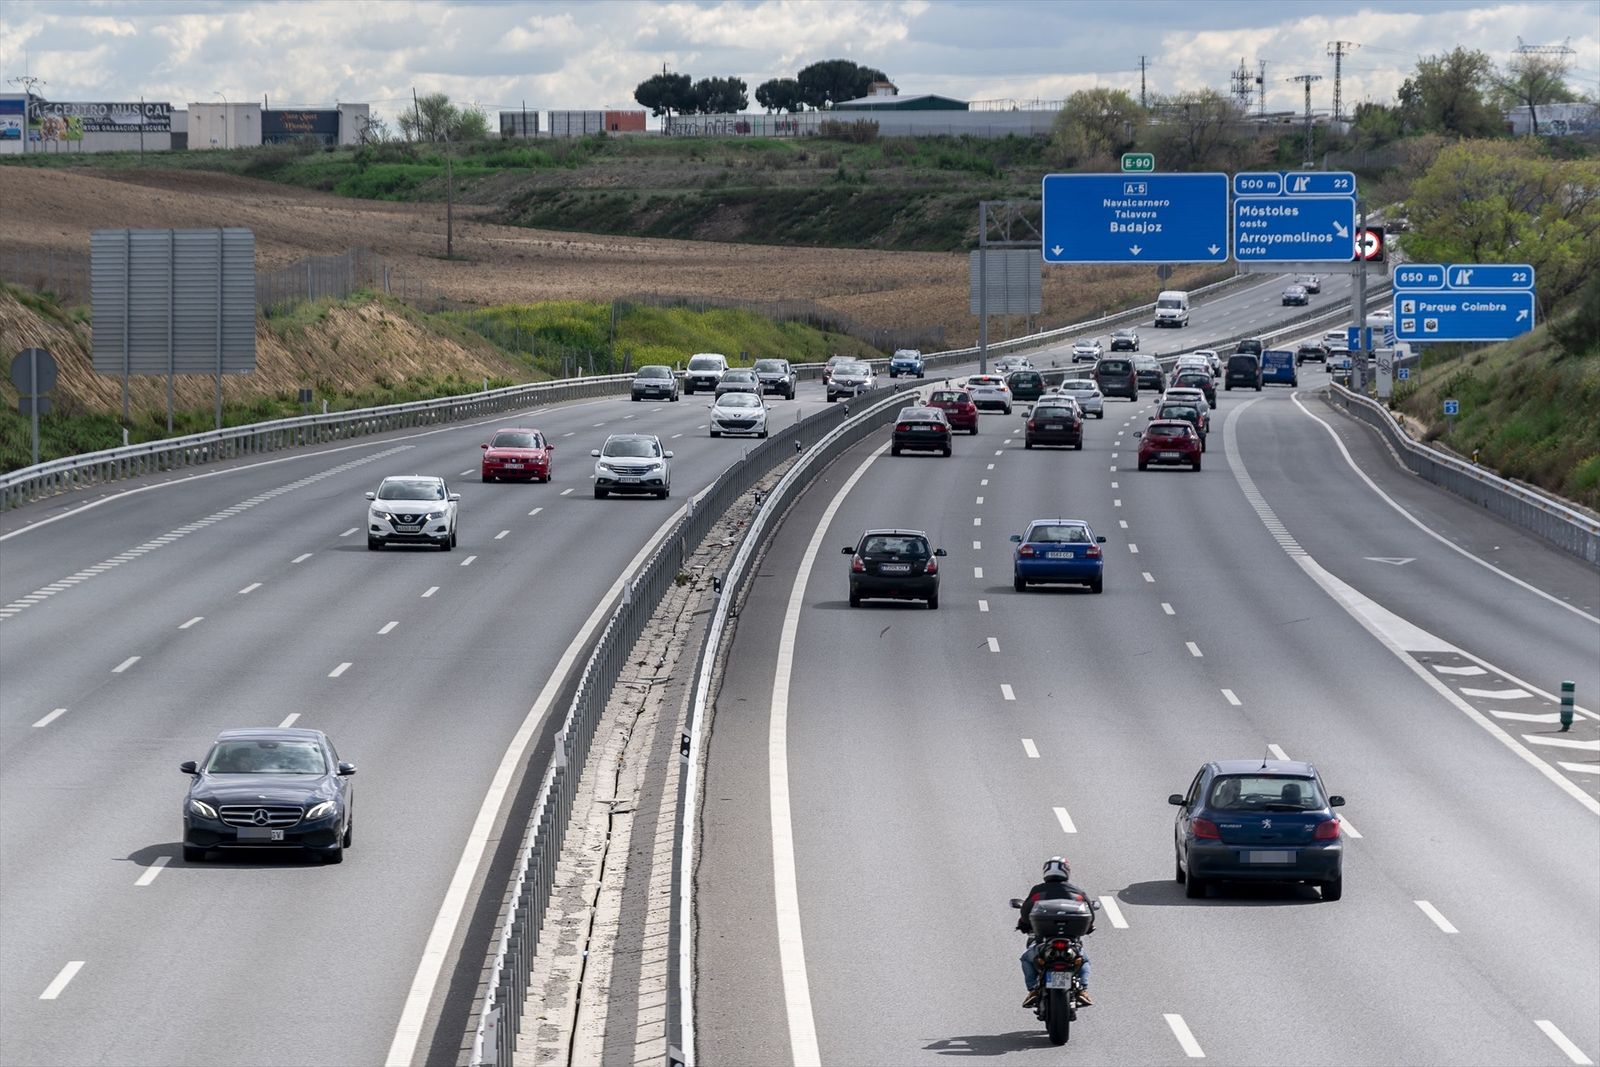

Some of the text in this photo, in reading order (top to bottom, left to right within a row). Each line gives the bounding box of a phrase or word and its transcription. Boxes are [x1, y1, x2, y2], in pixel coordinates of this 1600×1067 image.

[54, 104, 107, 116] CENTRO
[1241, 180, 1276, 189] 500 m
[1334, 179, 1348, 188] 22
[1103, 198, 1170, 207] Navalcarnero
[1115, 210, 1157, 218] Talavera
[1239, 205, 1299, 216] Móstoles
[1110, 221, 1162, 234] Badajoz
[1239, 219, 1268, 228] oeste
[1240, 231, 1333, 244] Arroyomolinos
[1239, 246, 1266, 255] norte
[1401, 273, 1438, 282] 650 m
[1511, 272, 1527, 282] 22
[1419, 302, 1507, 313] Parque Coimbra
